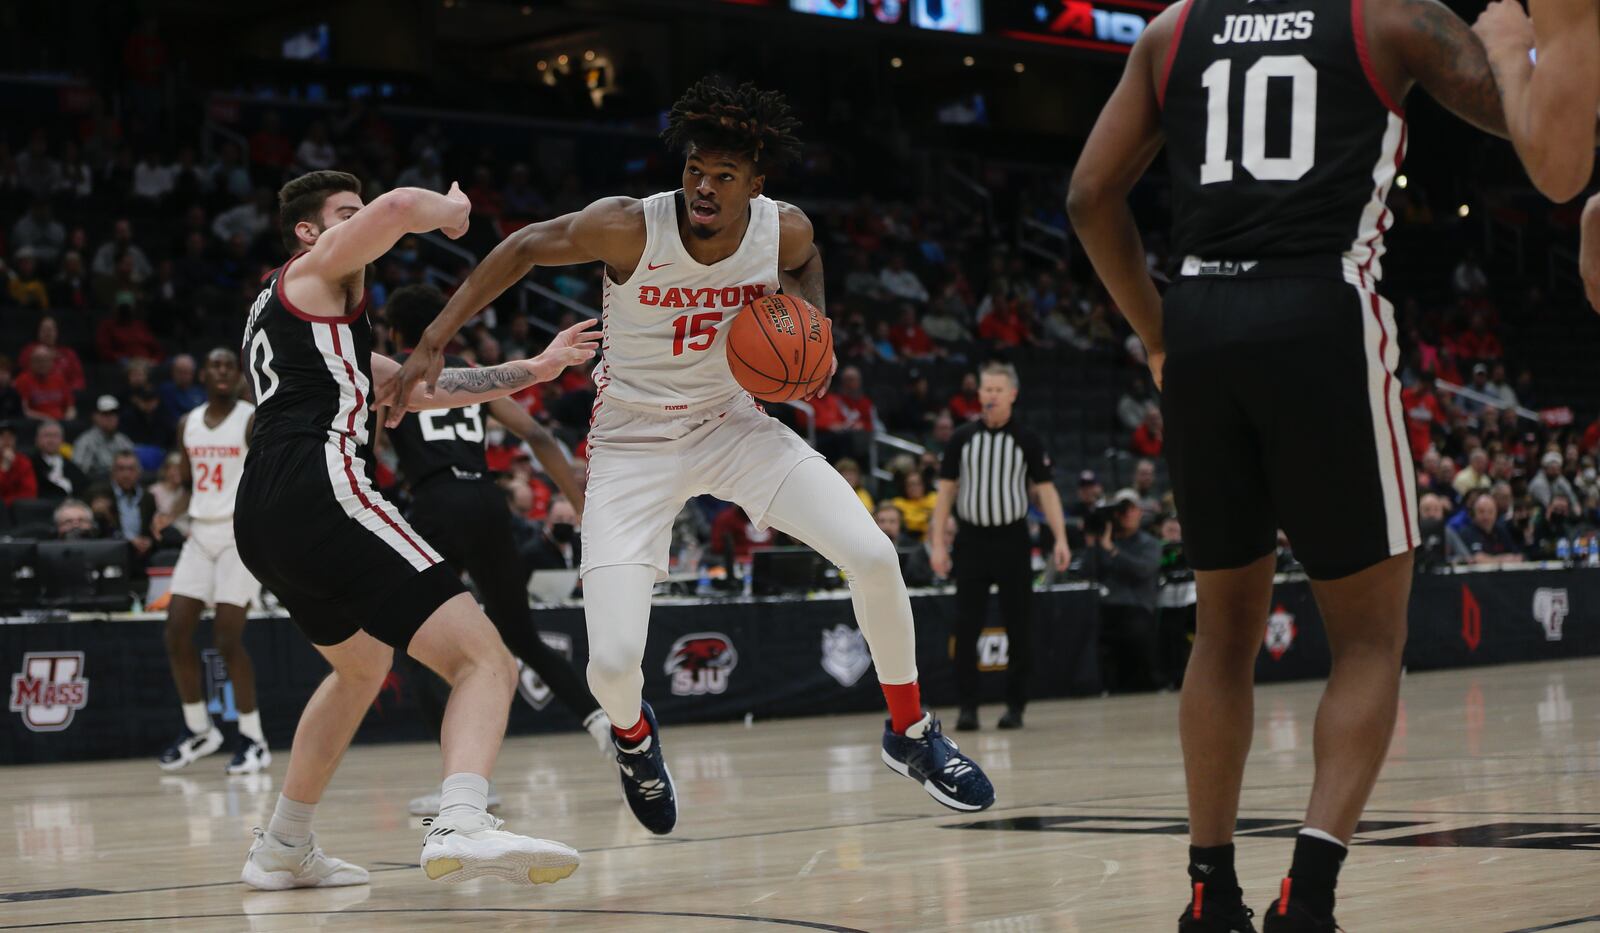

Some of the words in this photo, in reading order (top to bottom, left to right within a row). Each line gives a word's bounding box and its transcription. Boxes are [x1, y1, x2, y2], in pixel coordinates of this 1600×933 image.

[1212, 10, 1315, 44] JONES
[1200, 55, 1317, 185] 10
[639, 284, 766, 308] DAYTON
[672, 311, 723, 356] 15
[250, 328, 279, 406] 0
[418, 403, 484, 443] 23
[196, 463, 223, 492] 24
[672, 668, 730, 695] SJU
